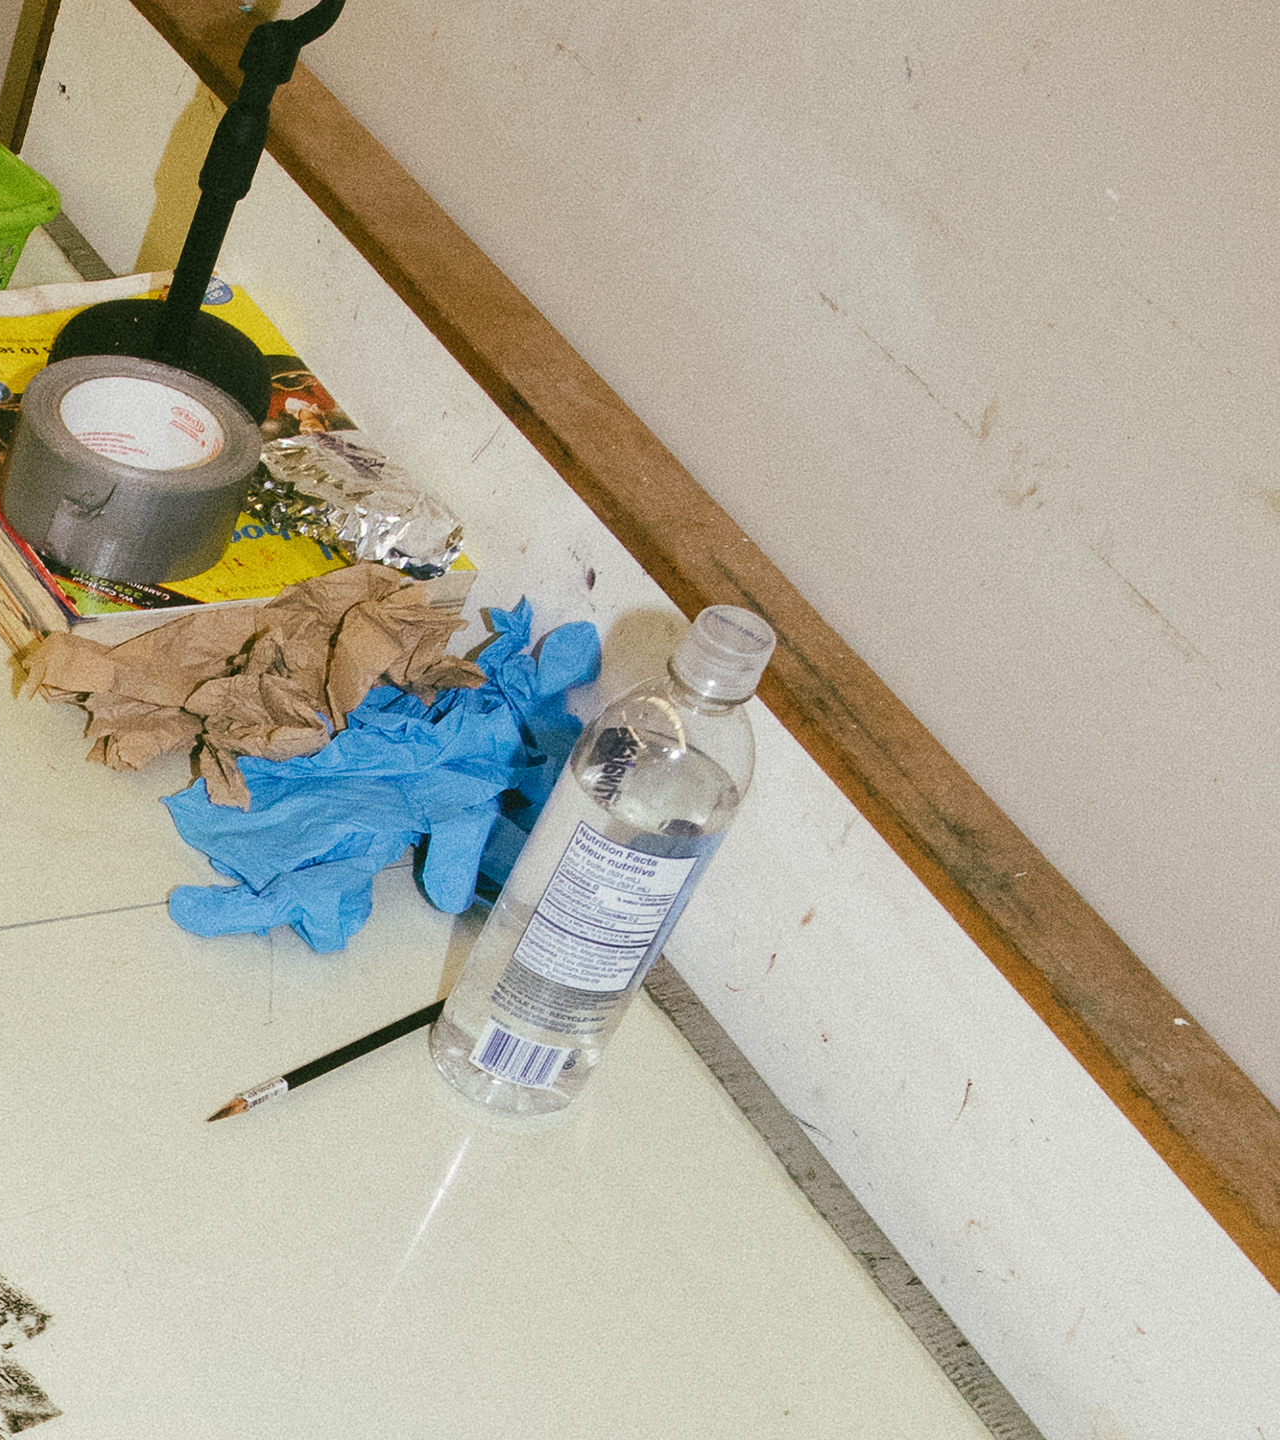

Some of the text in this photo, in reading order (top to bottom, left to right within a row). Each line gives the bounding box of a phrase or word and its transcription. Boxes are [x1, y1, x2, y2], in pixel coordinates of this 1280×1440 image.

[19, 345, 38, 355] to
[574, 837, 655, 878] Valeur nutritive
[578, 826, 658, 867] Nutrition Facts
[560, 864, 591, 887] Calories
